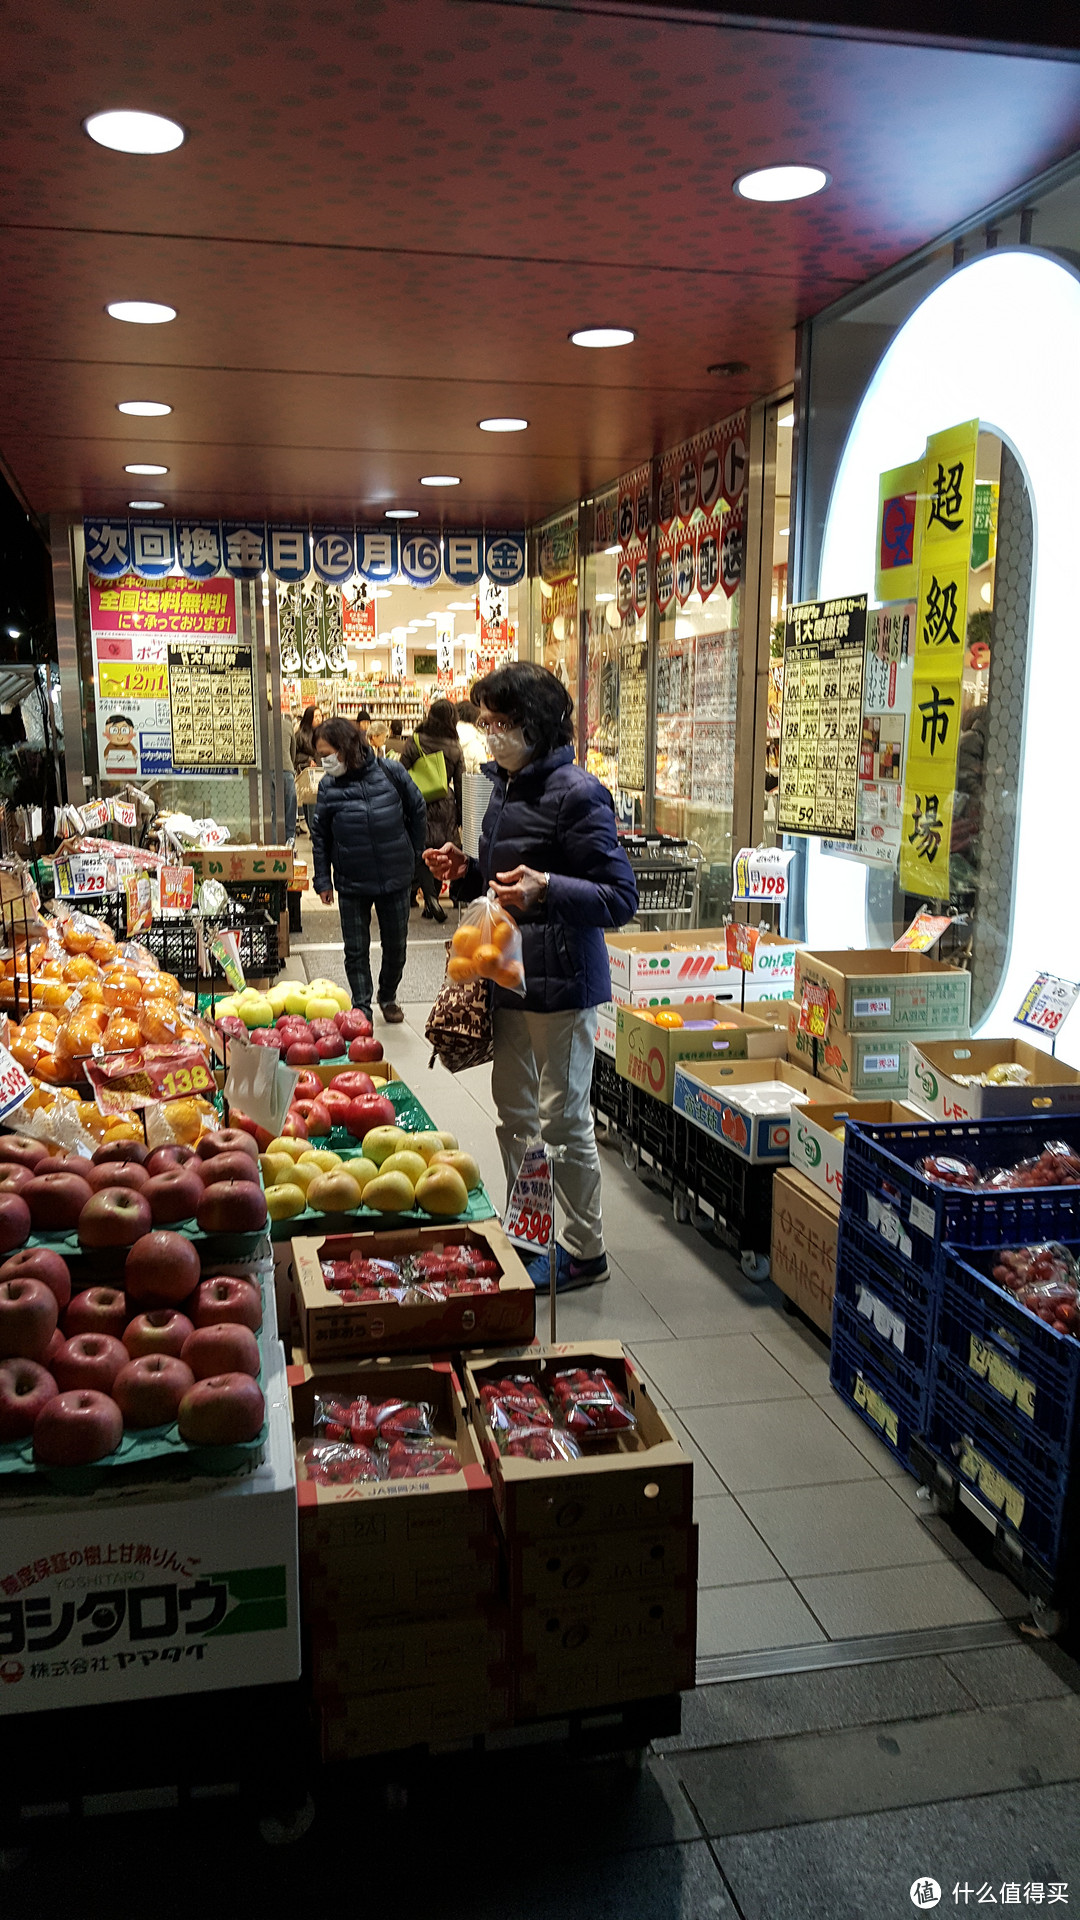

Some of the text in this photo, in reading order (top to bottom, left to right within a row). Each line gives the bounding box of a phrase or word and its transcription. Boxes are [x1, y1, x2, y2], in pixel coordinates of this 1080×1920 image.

[98, 590, 228, 615] 全国送料無料!
[119, 614, 231, 632] にて承っております!
[137, 646, 166, 660] ポイ
[909, 461, 964, 863] 超級市場
[823, 683, 838, 698] 88
[785, 722, 799, 738] 138
[824, 723, 838, 738] 73
[198, 751, 213, 759] 59
[844, 755, 856, 769] 99
[122, 809, 134, 825] 128
[799, 807, 814, 821] 59
[163, 1065, 209, 1097] 138
[55, 1570, 145, 1591] YOSHITARO
